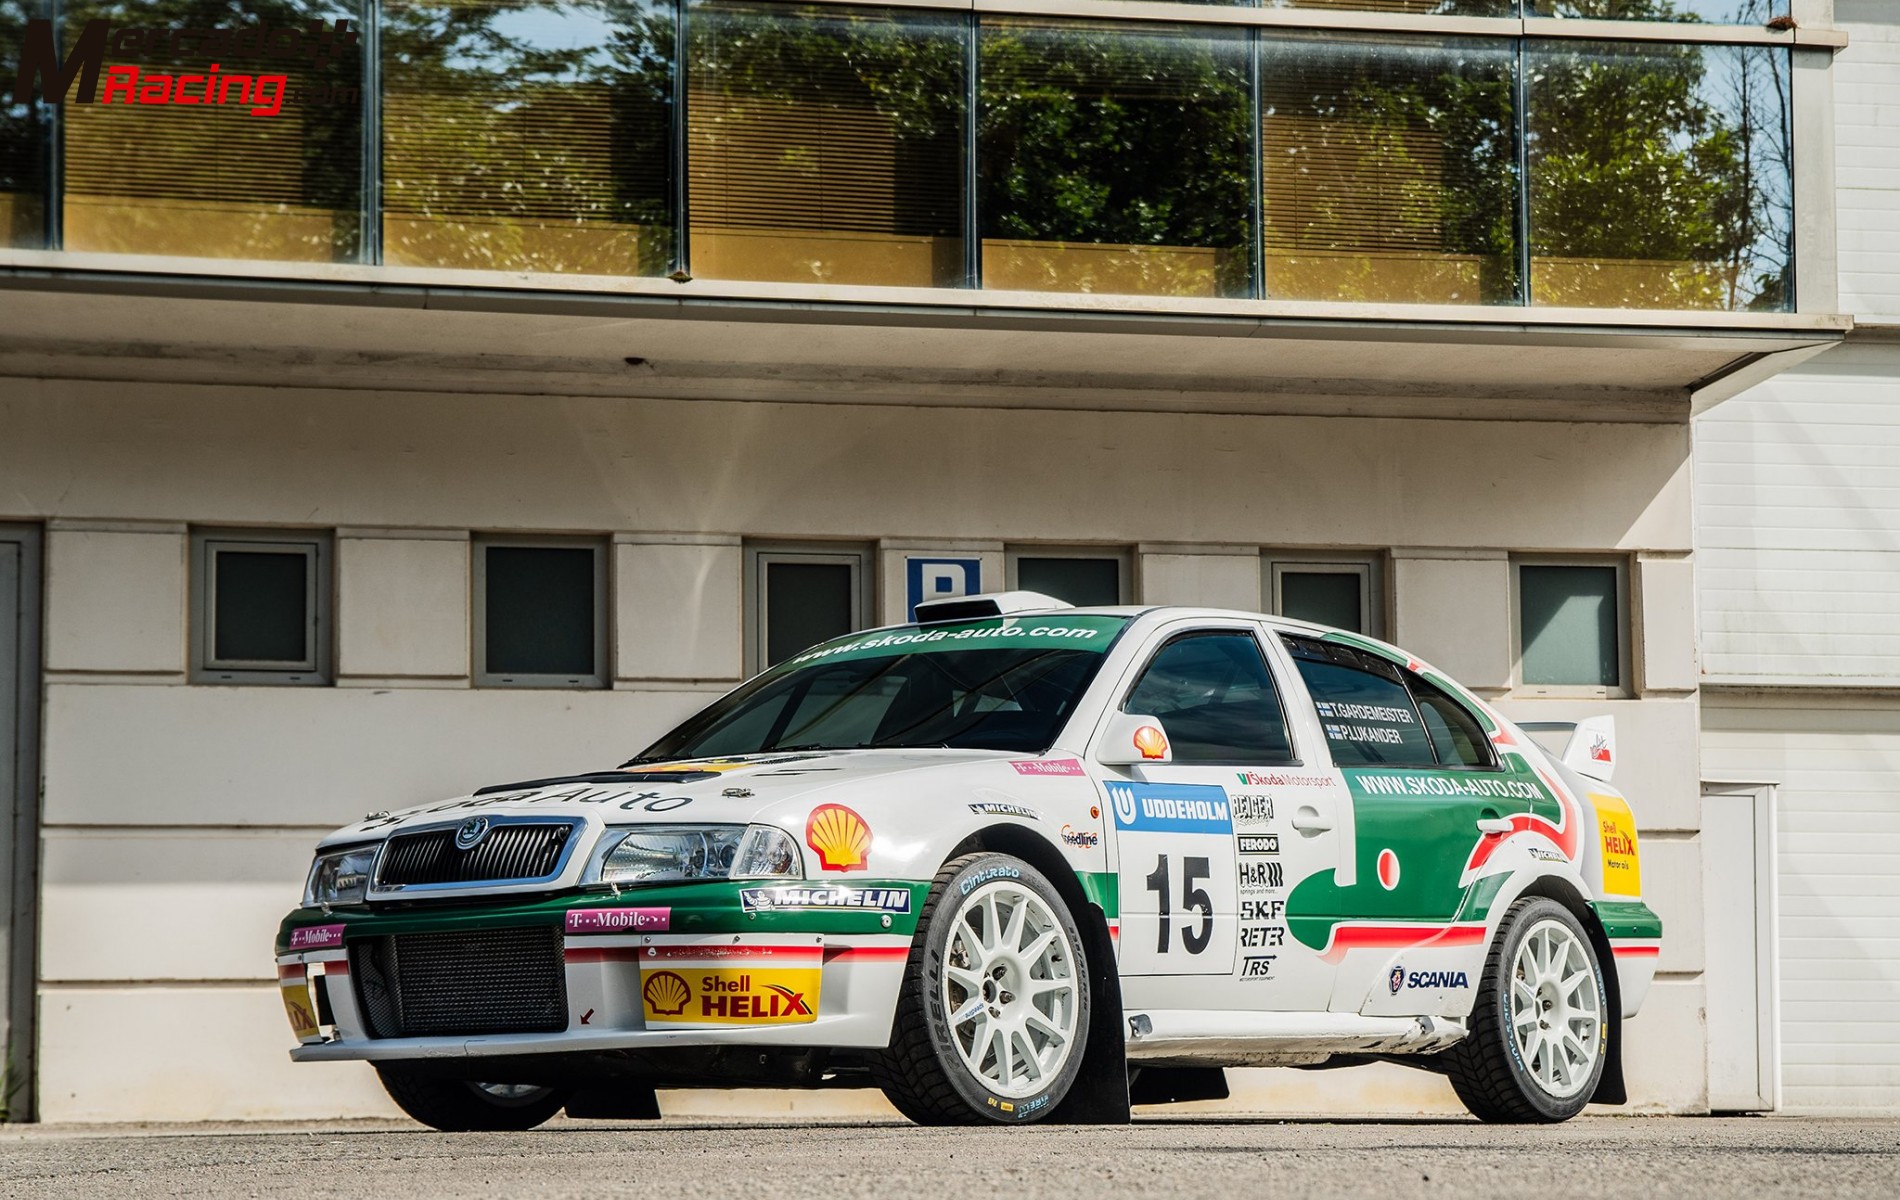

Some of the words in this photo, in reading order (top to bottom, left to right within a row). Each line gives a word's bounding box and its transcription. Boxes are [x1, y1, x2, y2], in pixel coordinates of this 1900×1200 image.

[922, 563, 966, 602] P
[792, 625, 1098, 664] www.skoda-auto.com
[1329, 702, 1414, 723] T.GARDEMEISTER
[1340, 724, 1403, 744] P.LUKANDER
[1356, 775, 1545, 800] WWW.SKODA-AUTO.COM
[1142, 799, 1228, 820] UDDEHOLM
[1603, 821, 1617, 834] Shell
[1240, 838, 1276, 851] FERODO
[1605, 831, 1636, 856] HELIX
[1239, 862, 1267, 886] H&R
[773, 890, 908, 907] MICHELIN
[1146, 853, 1213, 955] 15
[1240, 900, 1285, 920] SKF
[702, 975, 750, 992] Shell
[1407, 972, 1469, 989] SCANIA
[701, 984, 813, 1018] HELIX
[929, 949, 962, 1070] PIRELLI
